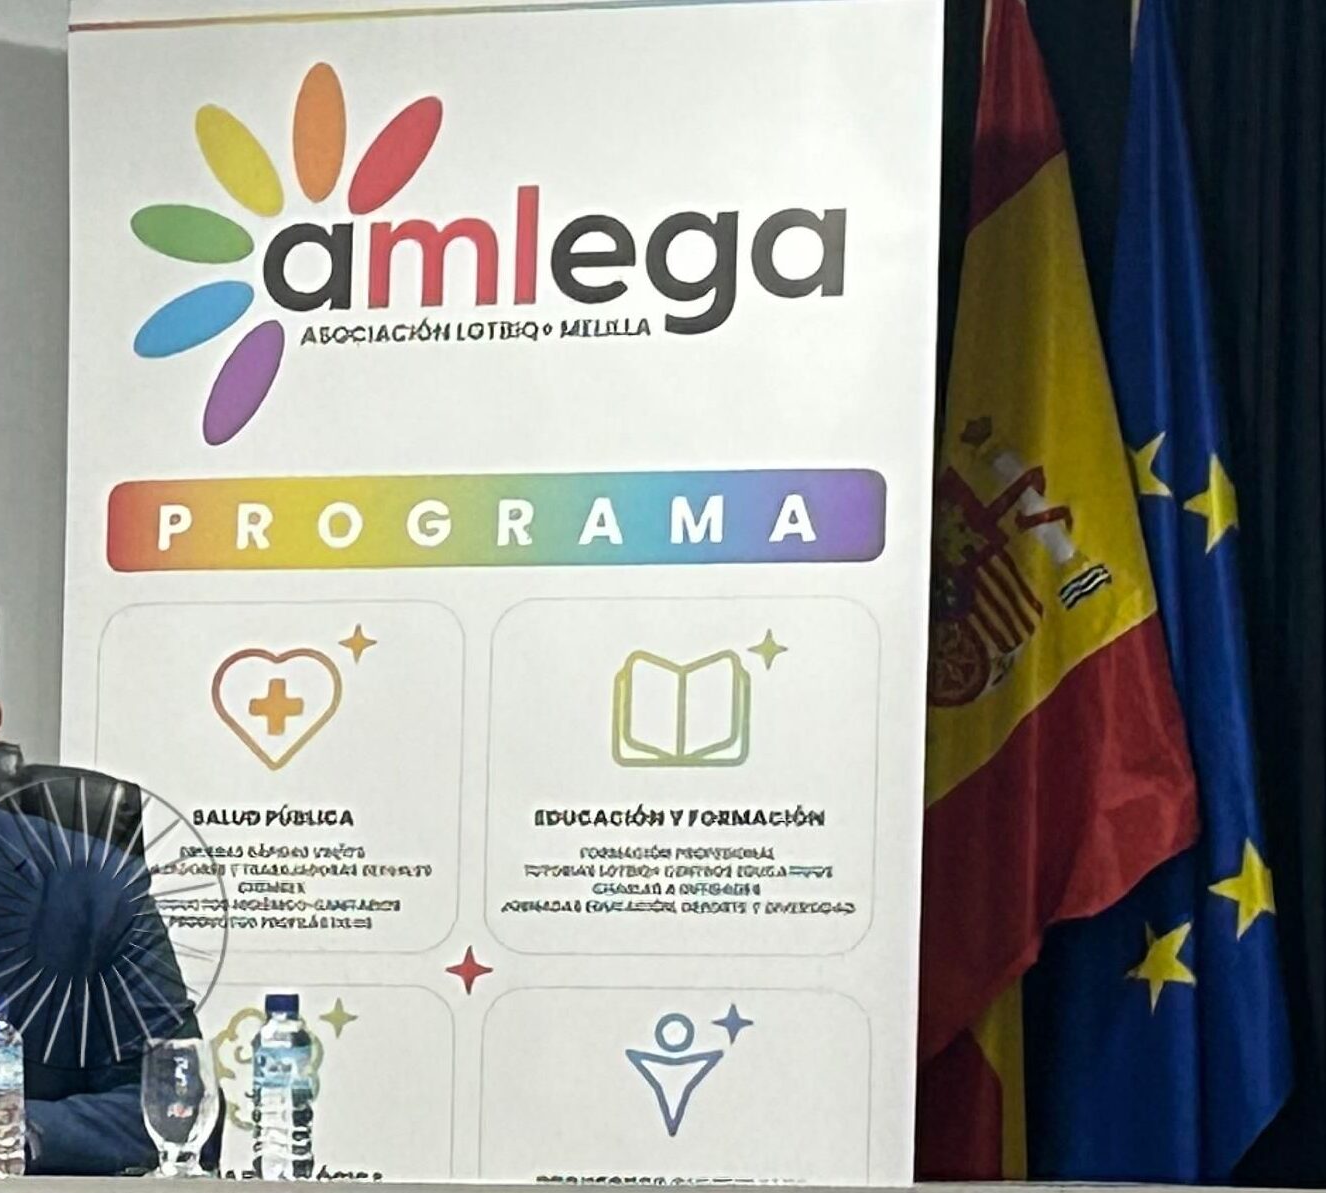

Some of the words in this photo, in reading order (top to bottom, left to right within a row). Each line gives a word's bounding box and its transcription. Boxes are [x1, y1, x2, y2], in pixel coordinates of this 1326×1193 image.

[262, 185, 848, 334] amlega
[157, 493, 816, 551] PROGRAMA
[669, 809, 685, 827] Y
